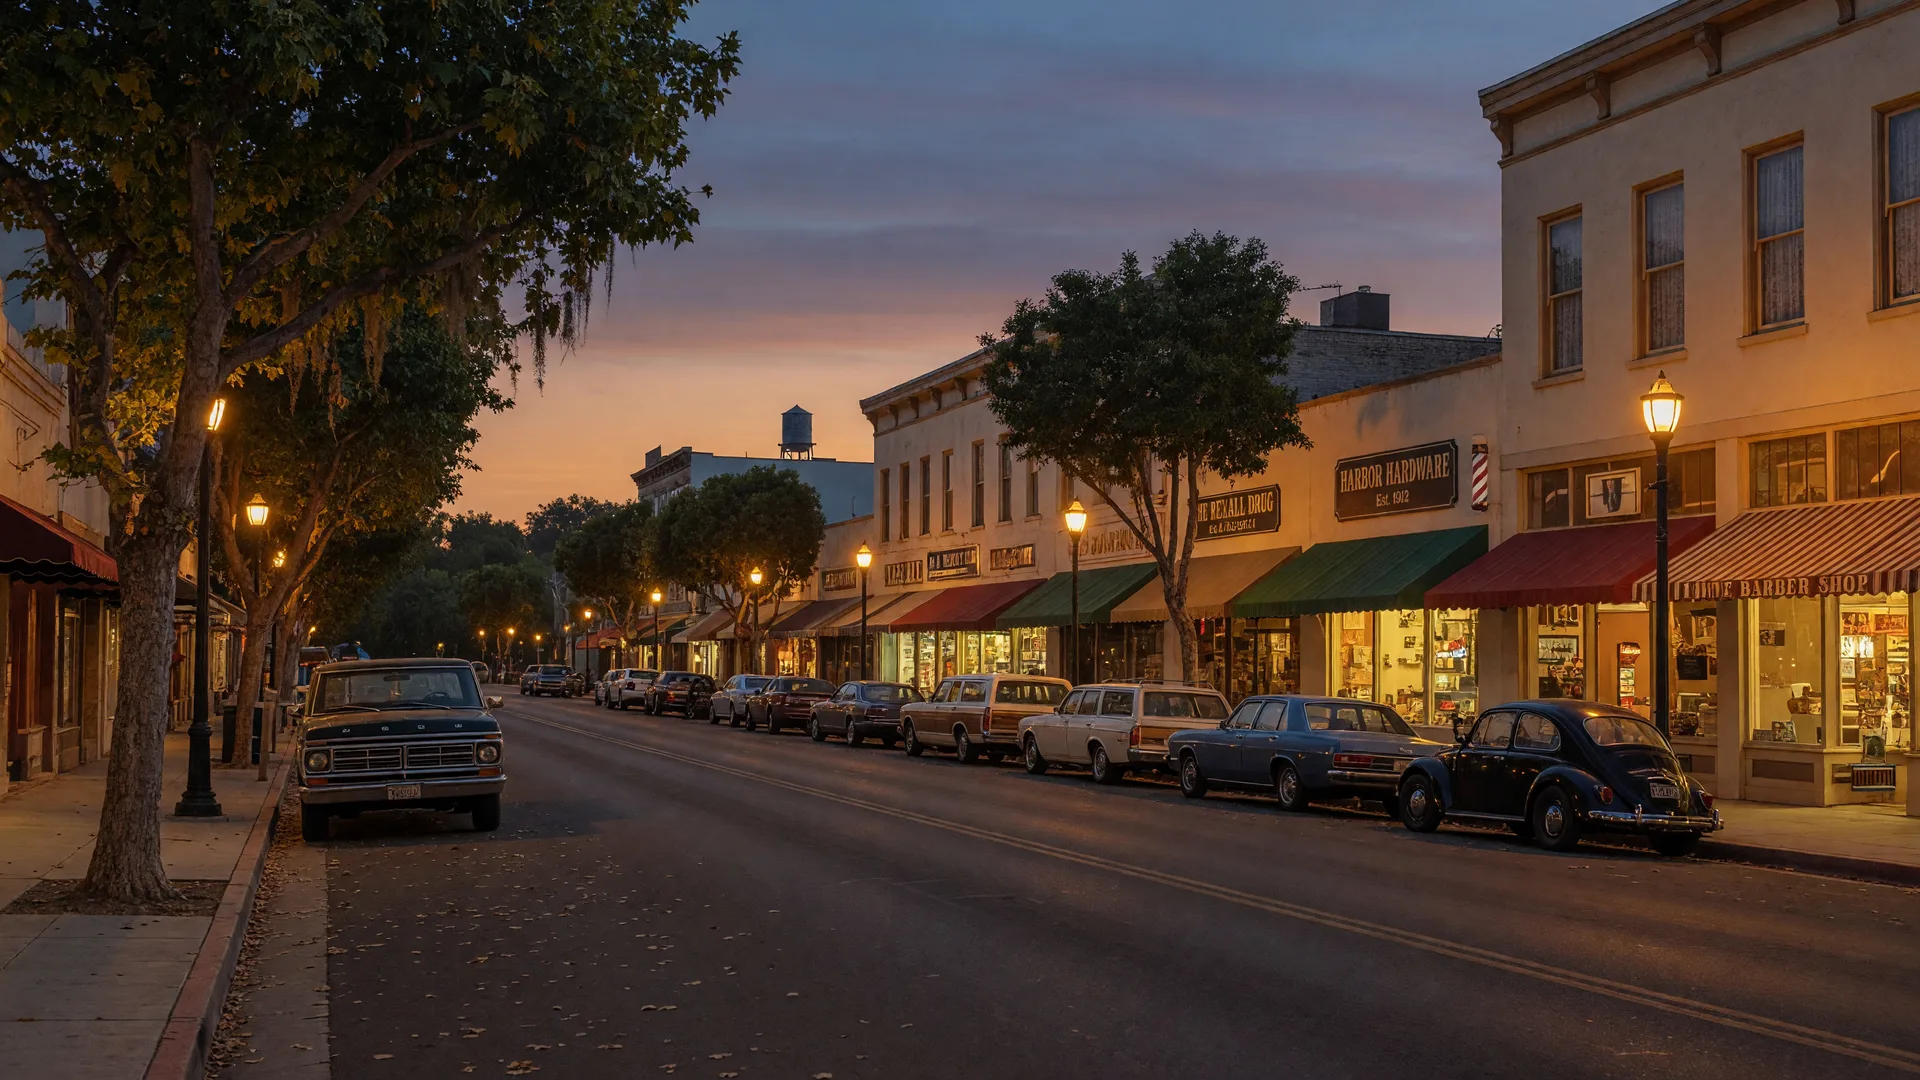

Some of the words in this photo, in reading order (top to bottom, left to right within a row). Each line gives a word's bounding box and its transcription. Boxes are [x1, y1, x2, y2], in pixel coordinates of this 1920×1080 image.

[1340, 464, 1383, 493] HARBOR
[1386, 452, 1450, 486] HARDWARE
[1210, 496, 1246, 521] REXALL
[1248, 491, 1274, 515] DRUG
[1376, 493, 1390, 507] Est.
[1393, 489, 1409, 504] 1912
[1740, 577, 1810, 598] BARBER
[1818, 574, 1868, 594] SHOP
